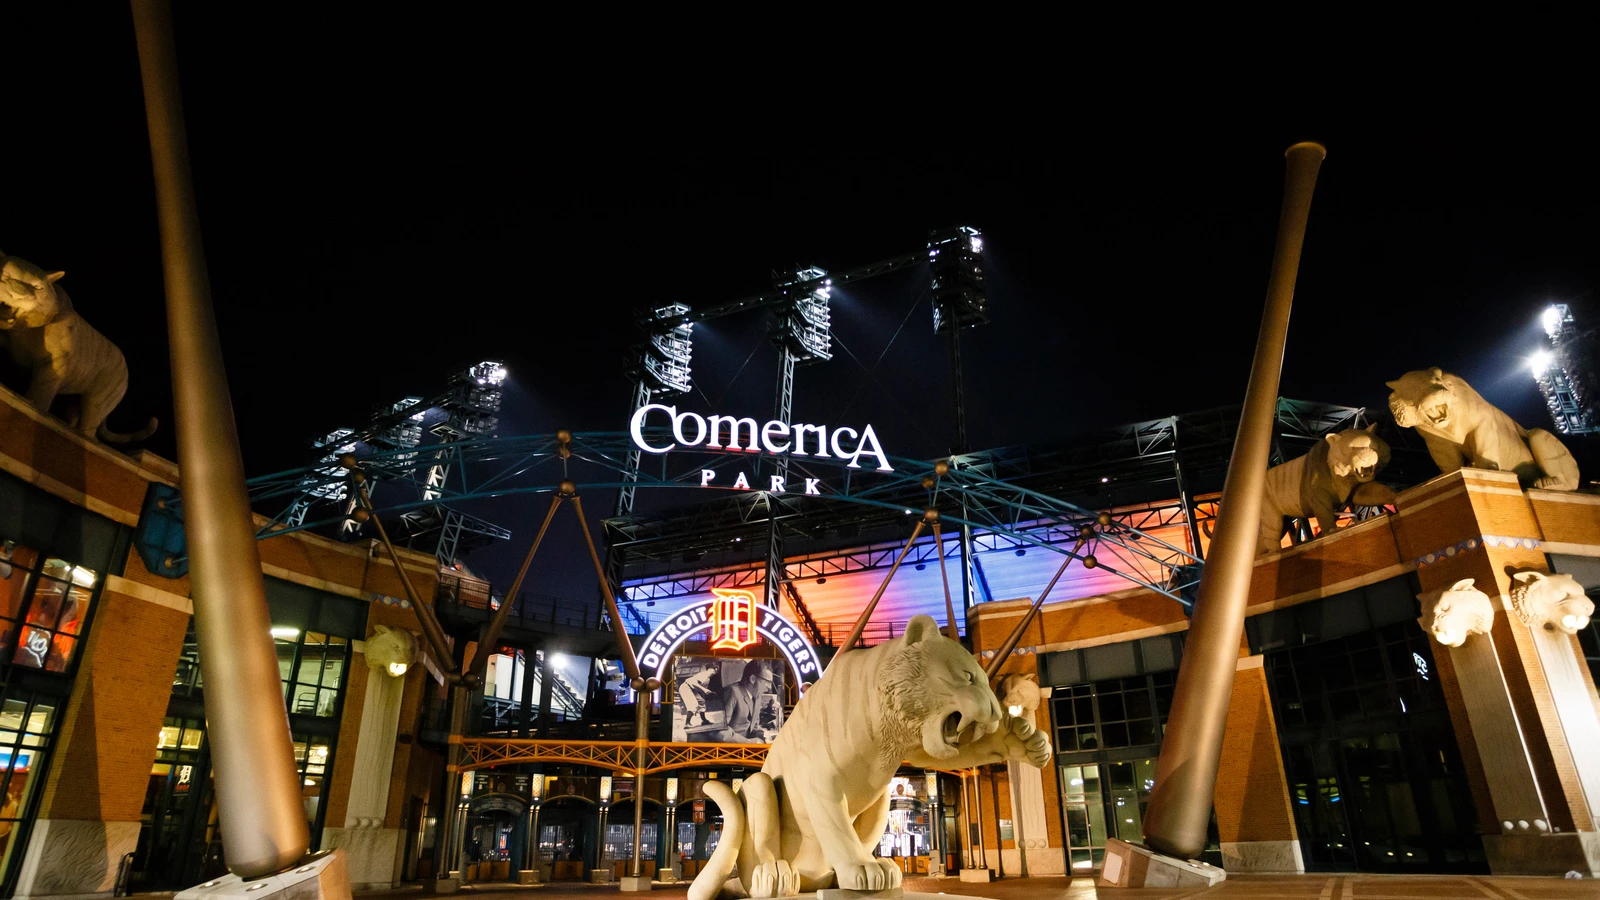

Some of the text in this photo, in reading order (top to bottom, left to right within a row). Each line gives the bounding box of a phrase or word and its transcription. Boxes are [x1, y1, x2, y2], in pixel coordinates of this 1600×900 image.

[701, 469, 821, 495] PARK
[642, 607, 816, 674] DETROIT TIGERS
